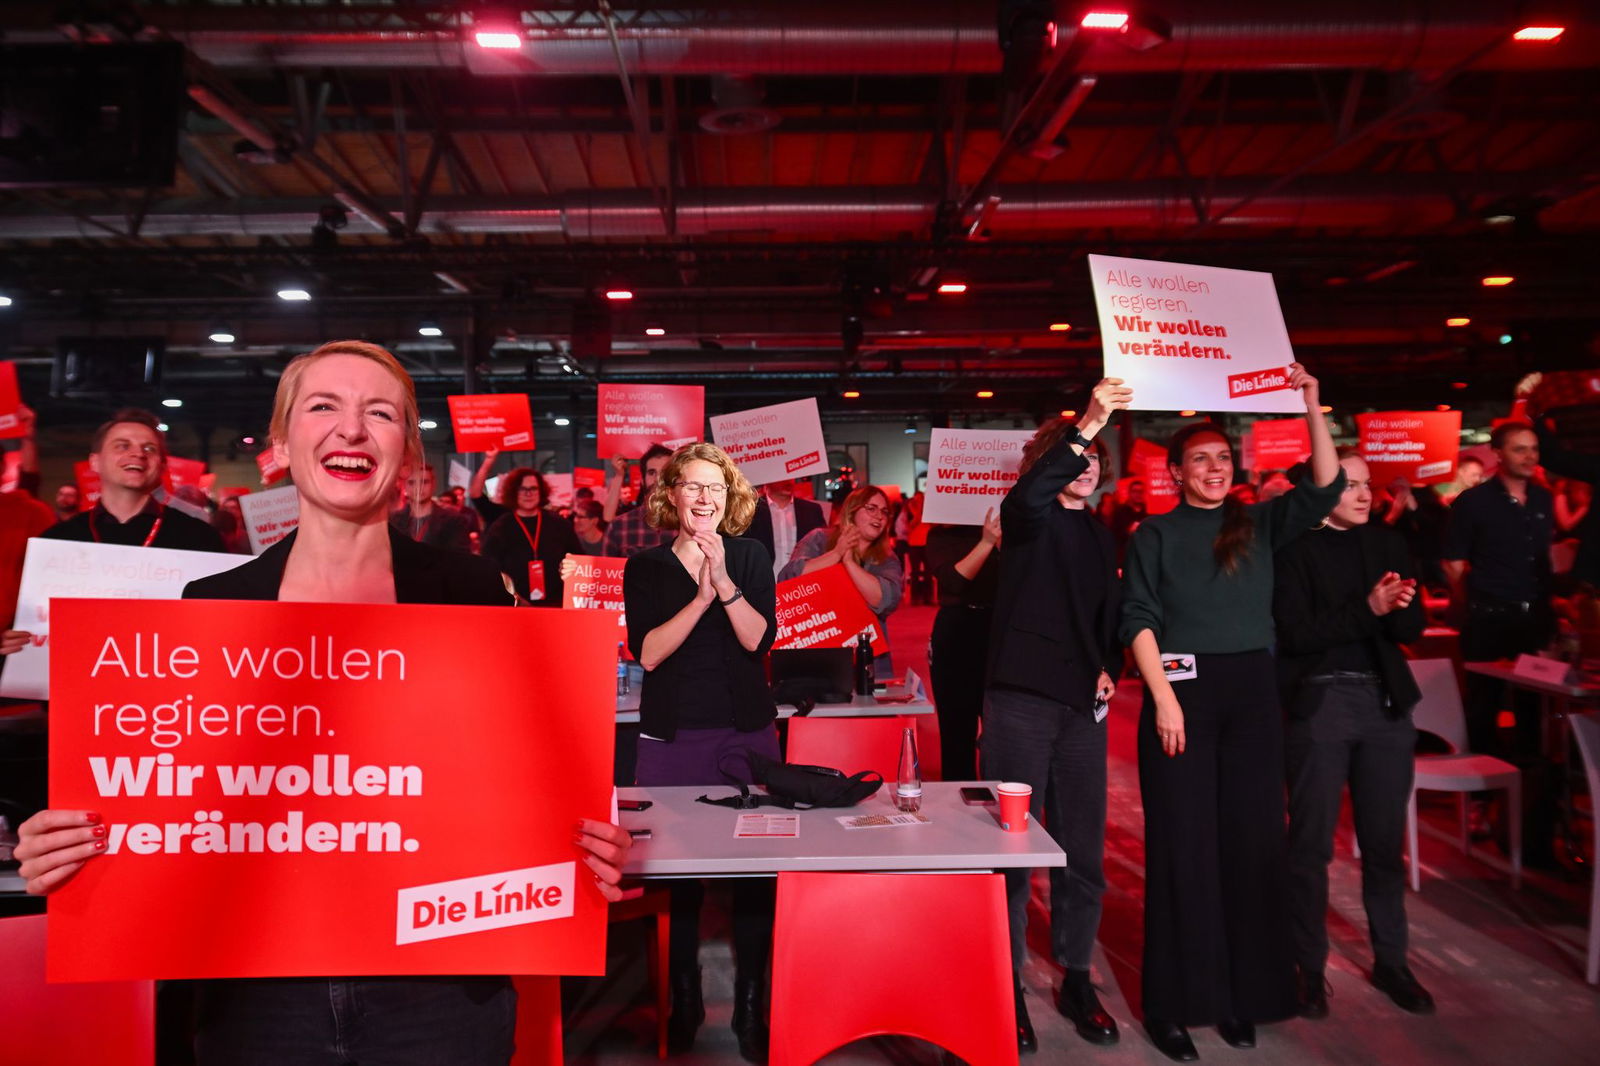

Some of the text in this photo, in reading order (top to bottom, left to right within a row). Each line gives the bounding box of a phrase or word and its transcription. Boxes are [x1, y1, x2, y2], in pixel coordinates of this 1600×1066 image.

[1107, 270, 1210, 295] Alle wollen
[1111, 293, 1193, 313] regieren.
[1114, 315, 1227, 338] Wir wollen
[1118, 339, 1232, 360] verändern.
[1232, 372, 1285, 394] Die Linke
[604, 413, 667, 424] Wir wollen
[723, 436, 786, 454] Wir wollen
[940, 438, 1018, 451] Alle wollen
[732, 447, 787, 465] erändern.
[939, 454, 998, 468] regieren.
[937, 468, 1018, 481] Wir wollen
[574, 565, 602, 578] Alle
[574, 582, 623, 596] regiere
[782, 582, 822, 603] wollen
[572, 596, 601, 609] Wir
[775, 602, 814, 626] gieren.
[793, 610, 837, 633] wollen
[90, 633, 406, 681] Alle wollen
[94, 695, 336, 748] regieren.
[88, 754, 423, 797] Wir wollen
[412, 879, 563, 929] Die Linke
